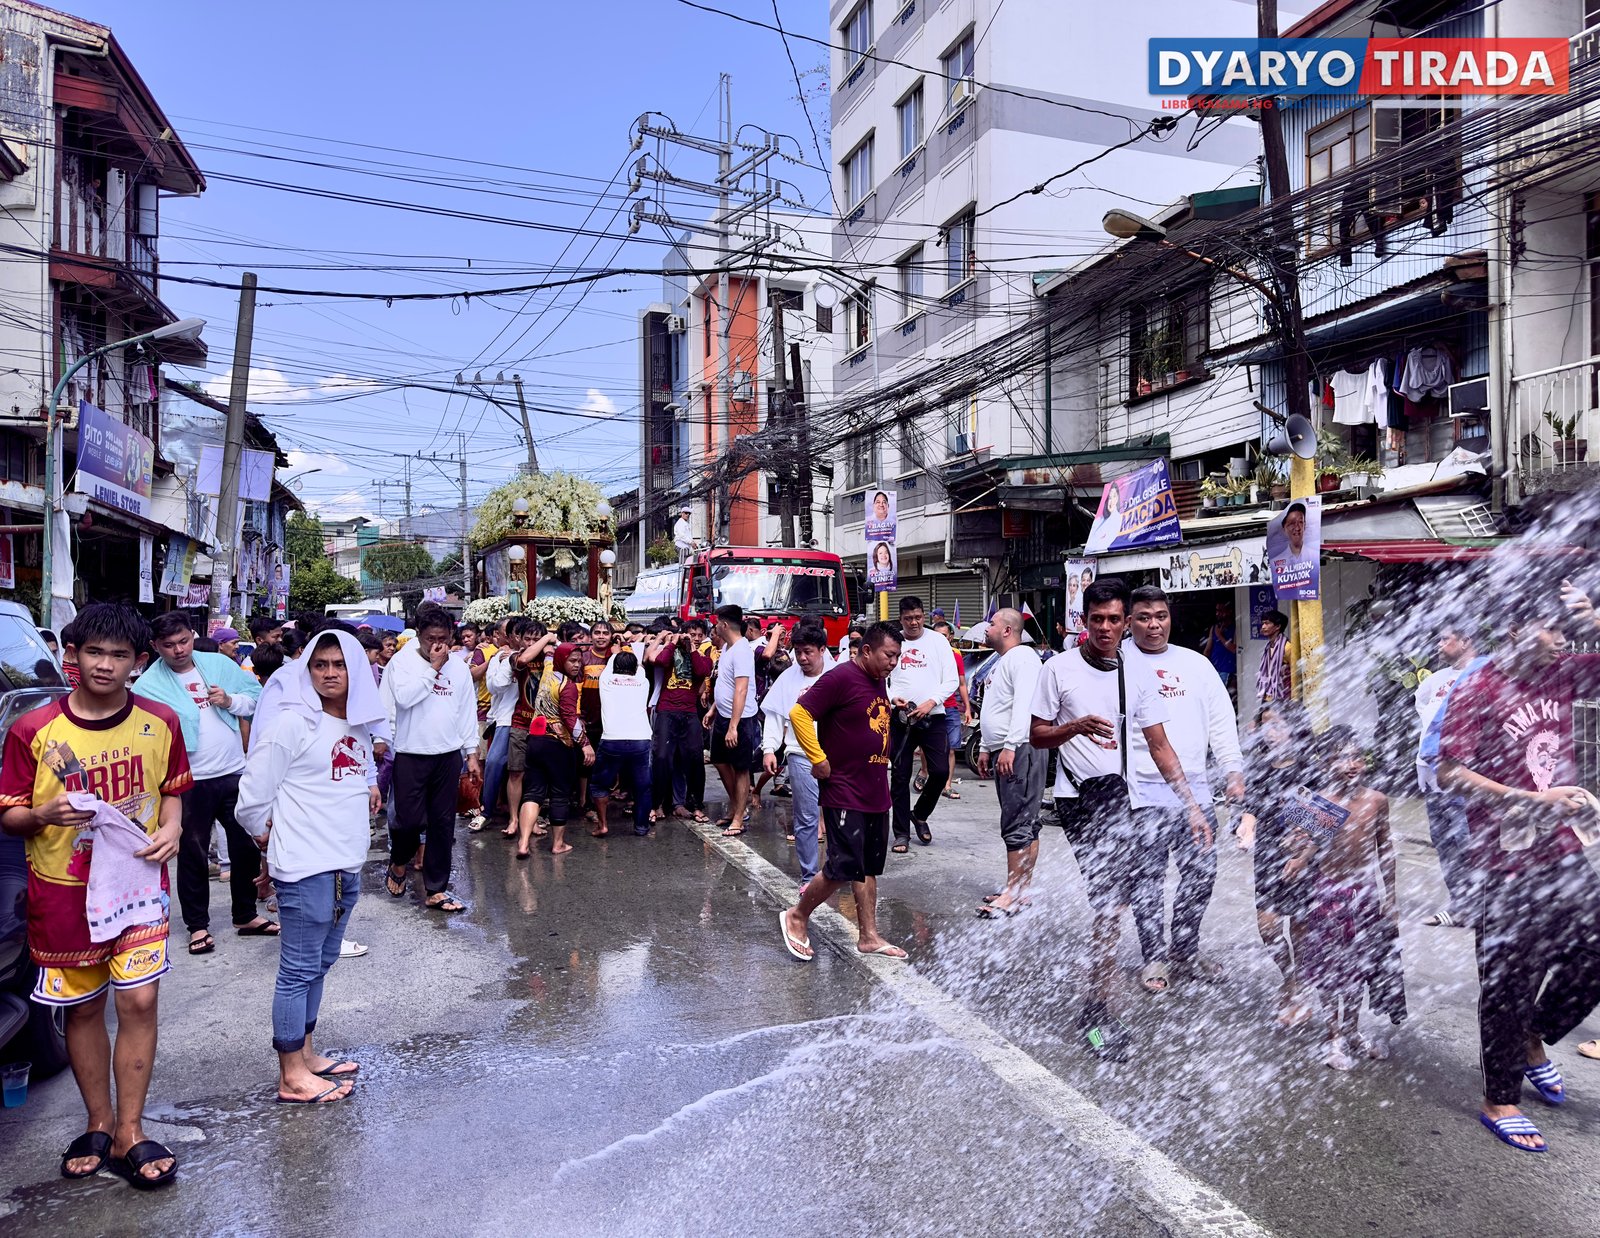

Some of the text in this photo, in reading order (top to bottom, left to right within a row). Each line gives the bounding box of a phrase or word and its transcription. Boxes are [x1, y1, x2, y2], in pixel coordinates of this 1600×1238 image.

[94, 484, 140, 514] LENIEL STORE
[766, 566, 836, 578] TANKER
[1212, 561, 1233, 569] SUPPLIES
[1254, 605, 1274, 613] GCash
[1501, 702, 1541, 741] AMA
[79, 746, 131, 768] SEÑOR
[64, 754, 146, 803] ABBA
